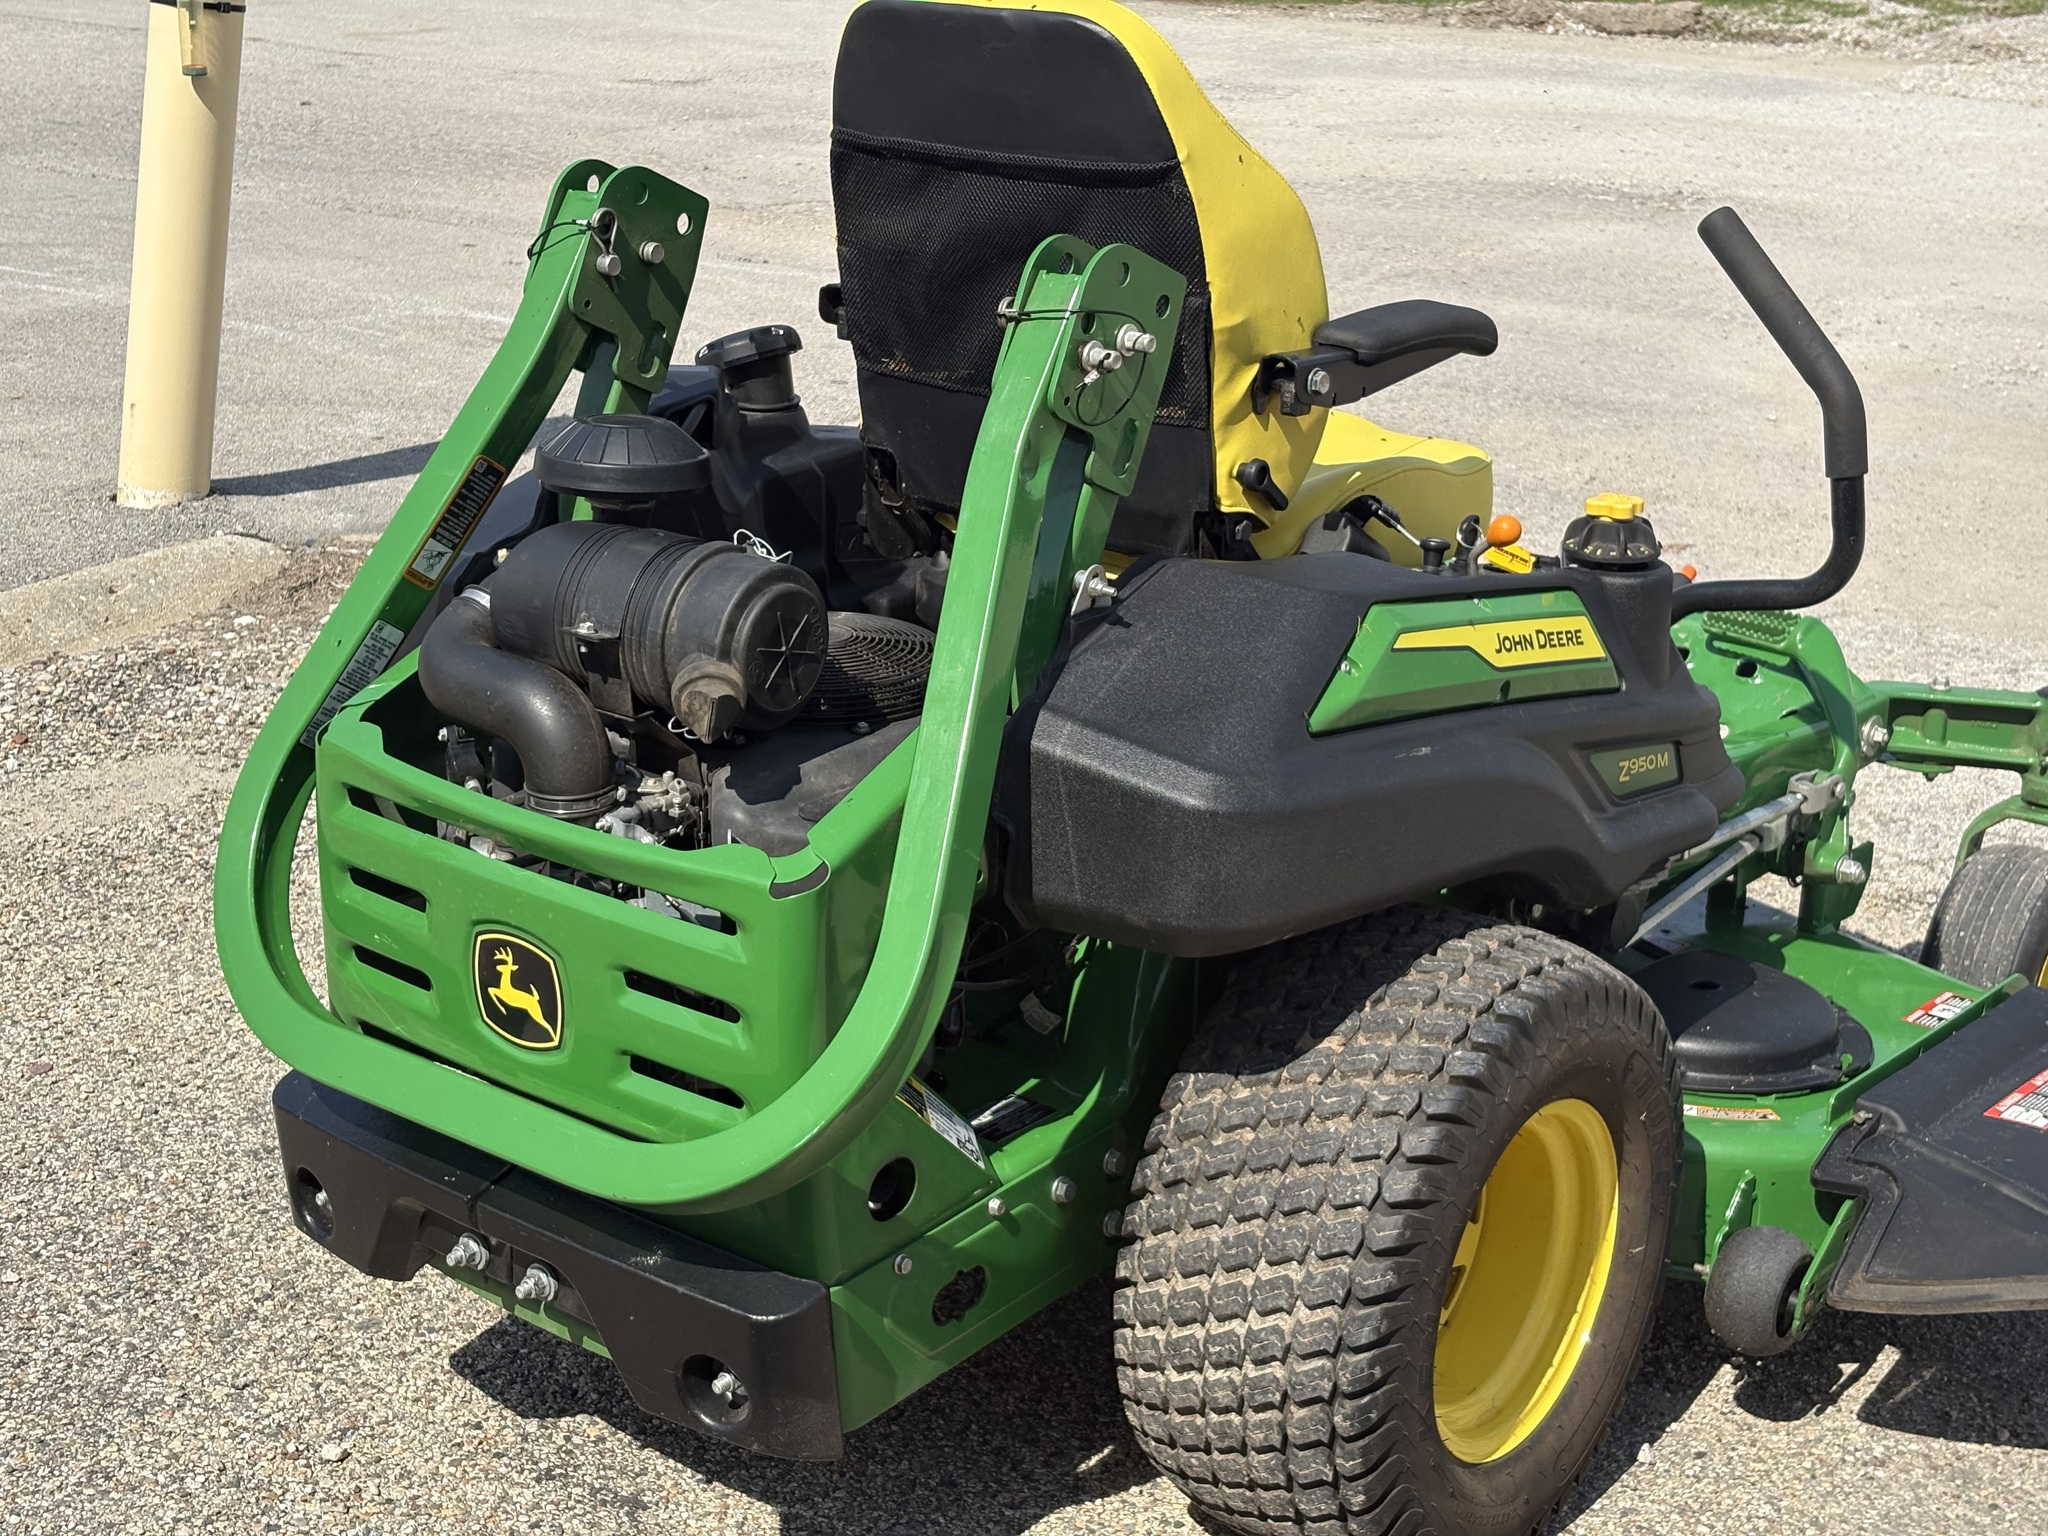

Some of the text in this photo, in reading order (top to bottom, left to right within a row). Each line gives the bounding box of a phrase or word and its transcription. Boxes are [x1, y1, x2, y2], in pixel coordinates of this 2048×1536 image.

[1495, 629, 1584, 654] JOHN DEERE
[1619, 752, 1669, 783] Z950M
